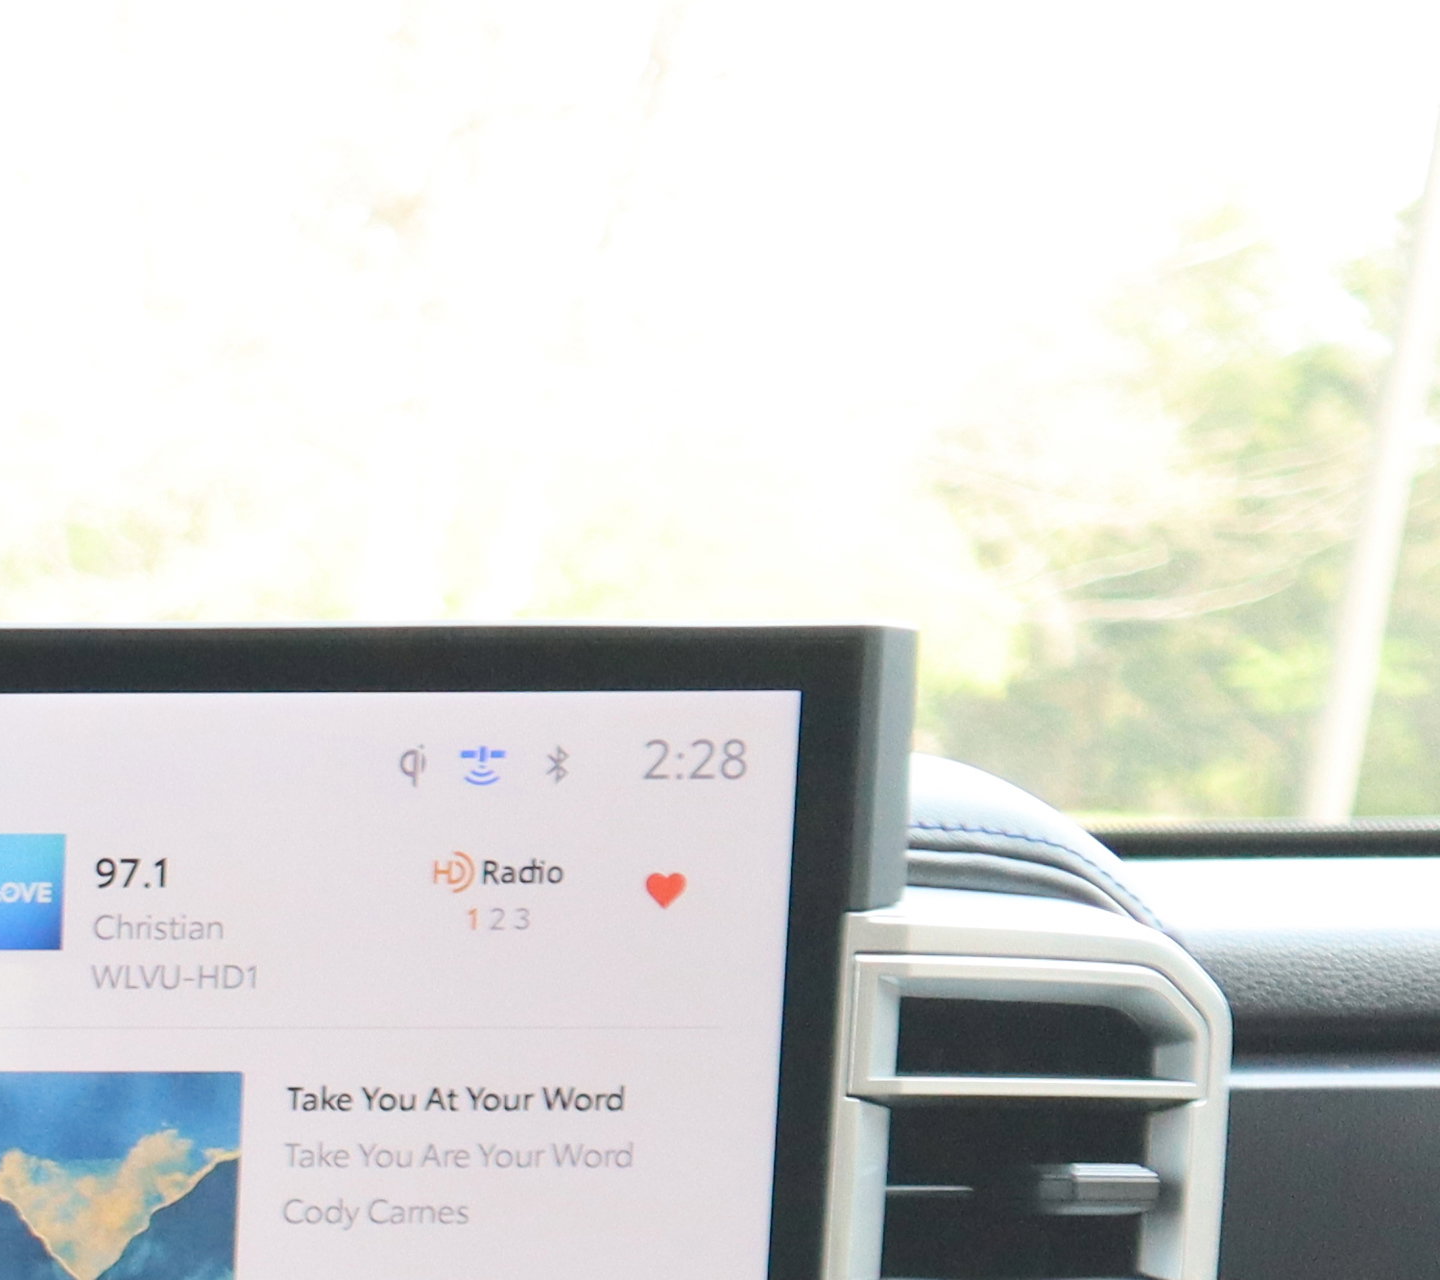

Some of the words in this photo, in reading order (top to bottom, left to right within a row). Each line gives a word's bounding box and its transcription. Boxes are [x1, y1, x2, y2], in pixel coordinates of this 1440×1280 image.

[642, 738, 748, 780] 2:28
[95, 857, 169, 889] 97.1
[482, 858, 564, 885] Radio
[92, 913, 225, 941] Christian
[468, 907, 479, 930] 1
[490, 907, 506, 930] 2
[514, 907, 531, 930] 3
[91, 964, 258, 990] WLVU-HD1
[287, 1085, 353, 1112] Take
[361, 1086, 416, 1112] You
[424, 1086, 459, 1112] At
[466, 1086, 534, 1112] Your
[542, 1085, 626, 1112] Word
[284, 1142, 350, 1168] Take
[358, 1143, 413, 1168] You
[420, 1143, 470, 1168] Are
[477, 1143, 544, 1168] Your
[551, 1142, 634, 1168] Word
[282, 1198, 360, 1231] Cody
